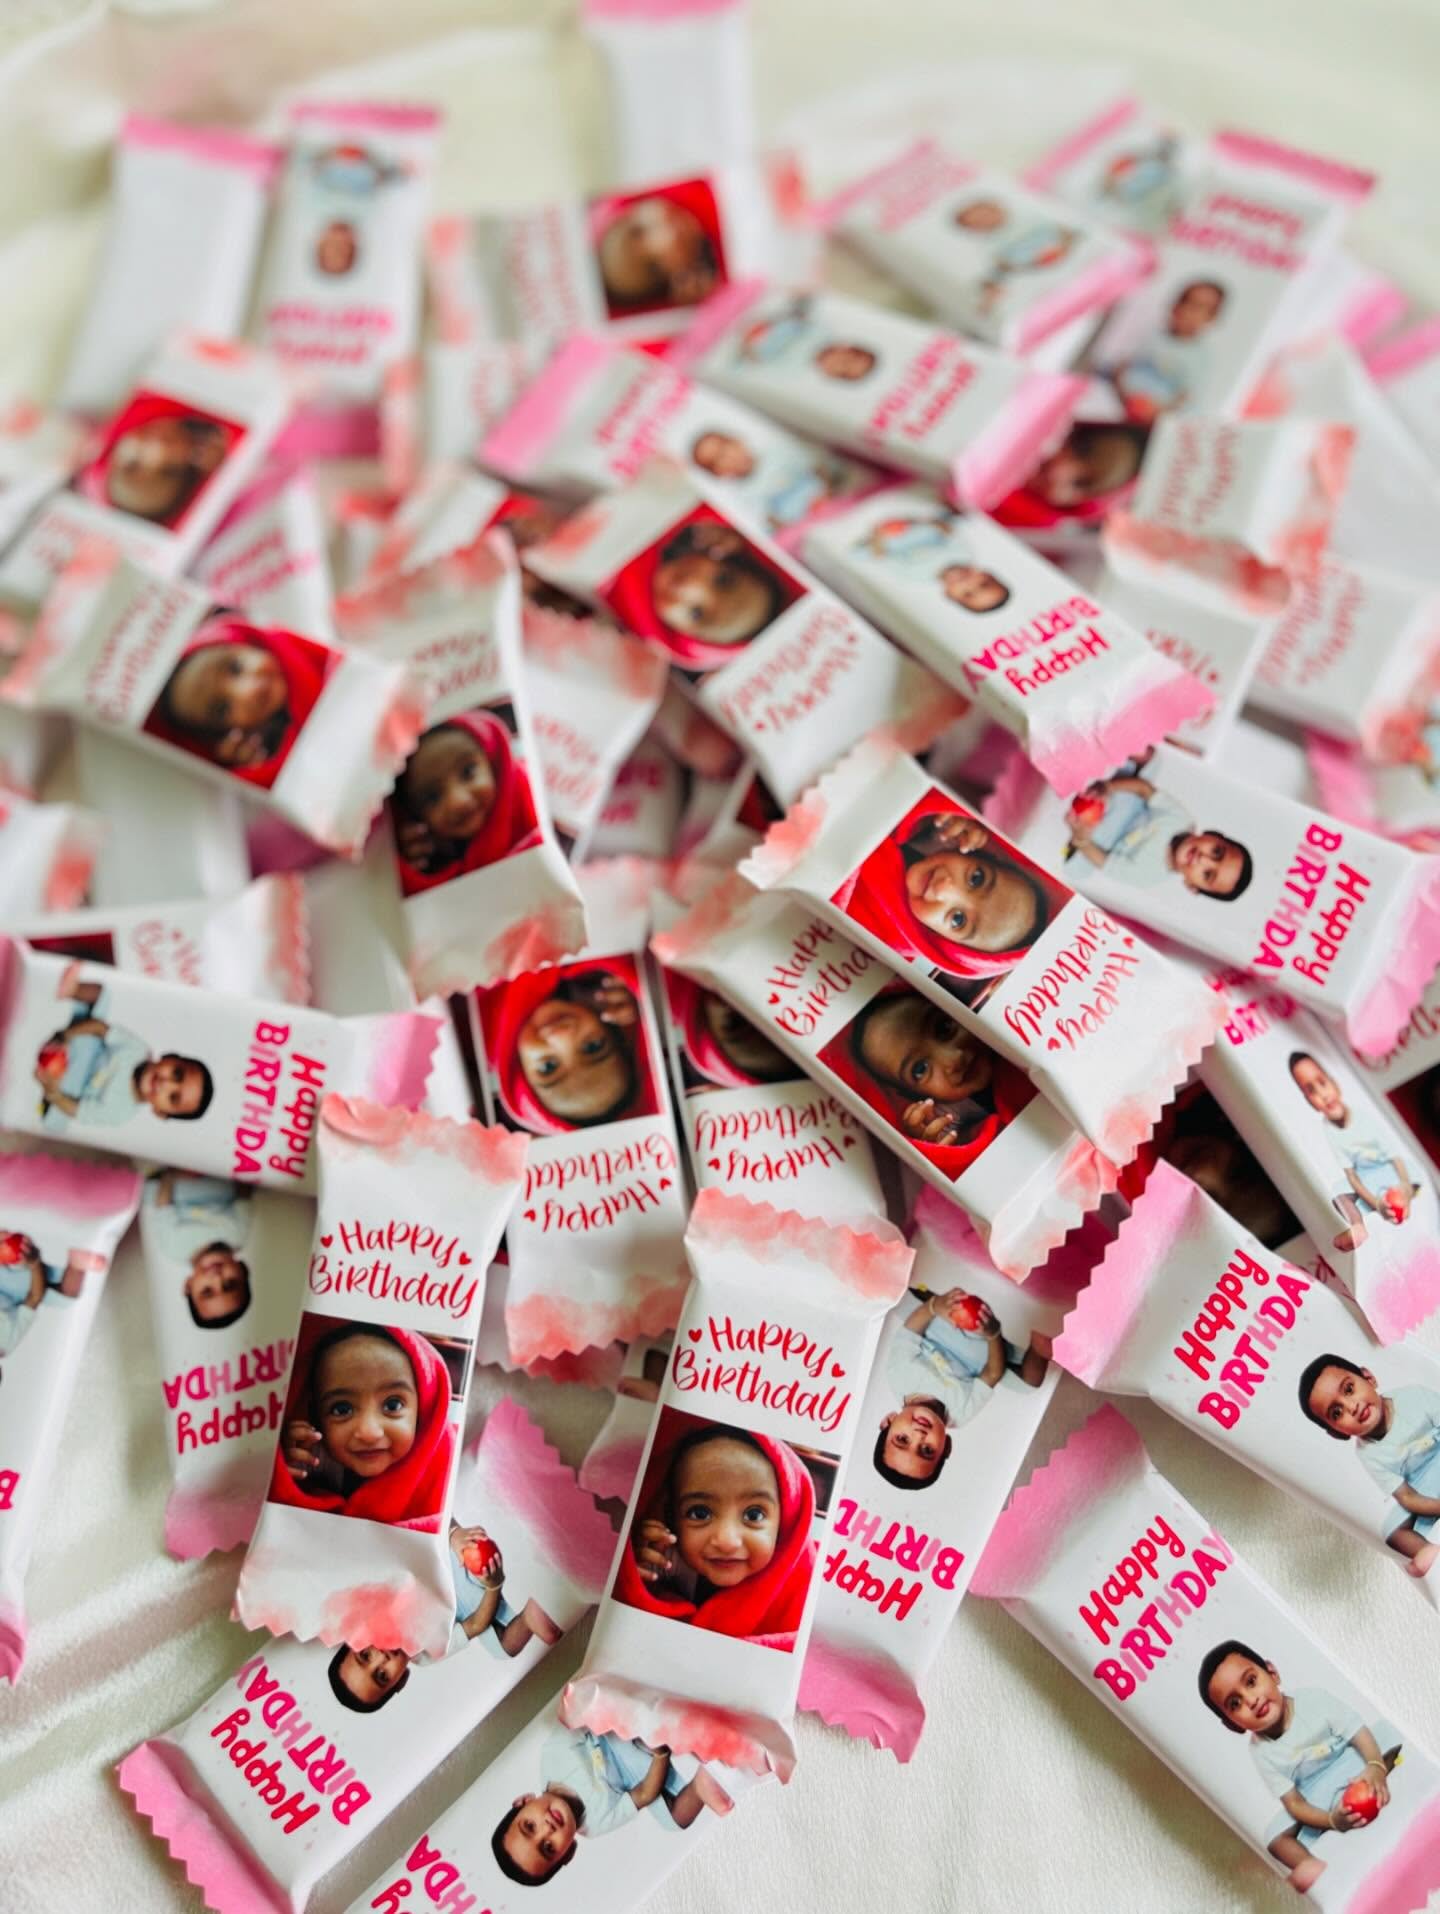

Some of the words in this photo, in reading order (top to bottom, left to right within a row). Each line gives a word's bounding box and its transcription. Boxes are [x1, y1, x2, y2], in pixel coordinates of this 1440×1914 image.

[1003, 625, 1111, 697] Happy
[1250, 824, 1343, 979] BIRTHDA
[1291, 862, 1372, 986] Happy
[766, 919, 834, 989] Happ
[774, 944, 877, 1037] Birthd
[1003, 908, 1119, 1047] Birthday
[1055, 952, 1140, 1051] Happy
[231, 1021, 290, 1181] BIRTHDA
[268, 1053, 327, 1179] Happy
[726, 1136, 845, 1183] Happy
[339, 1220, 460, 1269] Happy
[542, 1180, 661, 1233] Happy
[308, 1253, 479, 1319] Birthday
[1173, 1248, 1270, 1381] Happy
[162, 1339, 294, 1410] IRTHDA
[672, 1344, 852, 1433] Birthday
[708, 1315, 833, 1378] Happy
[822, 1548, 923, 1622] Happ
[1079, 1514, 1186, 1646] Happy
[1093, 1527, 1235, 1701] BIRTHDAY
[210, 1707, 321, 1835] Happy
